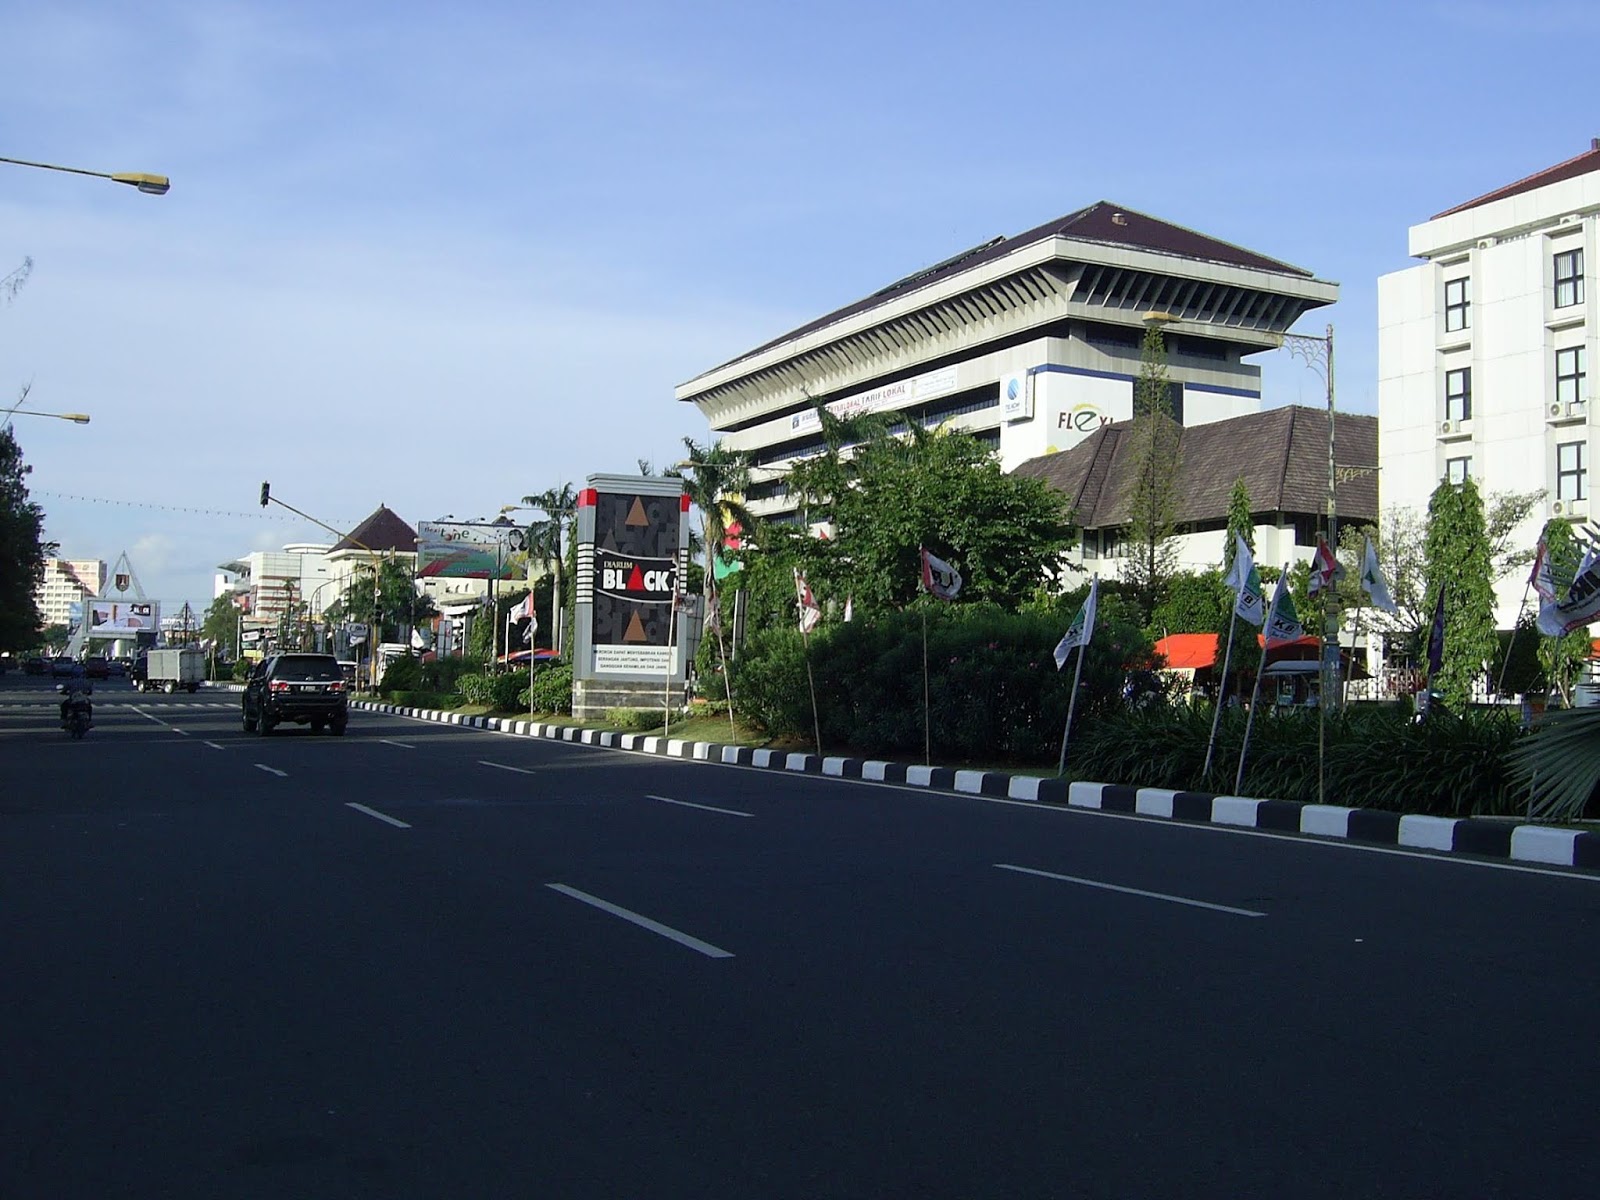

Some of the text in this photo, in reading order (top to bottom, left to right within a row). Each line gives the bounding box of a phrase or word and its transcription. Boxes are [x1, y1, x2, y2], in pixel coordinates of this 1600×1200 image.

[862, 391, 882, 405] TARIF
[883, 384, 906, 399] LOKAL
[603, 569, 669, 591] BLACK
